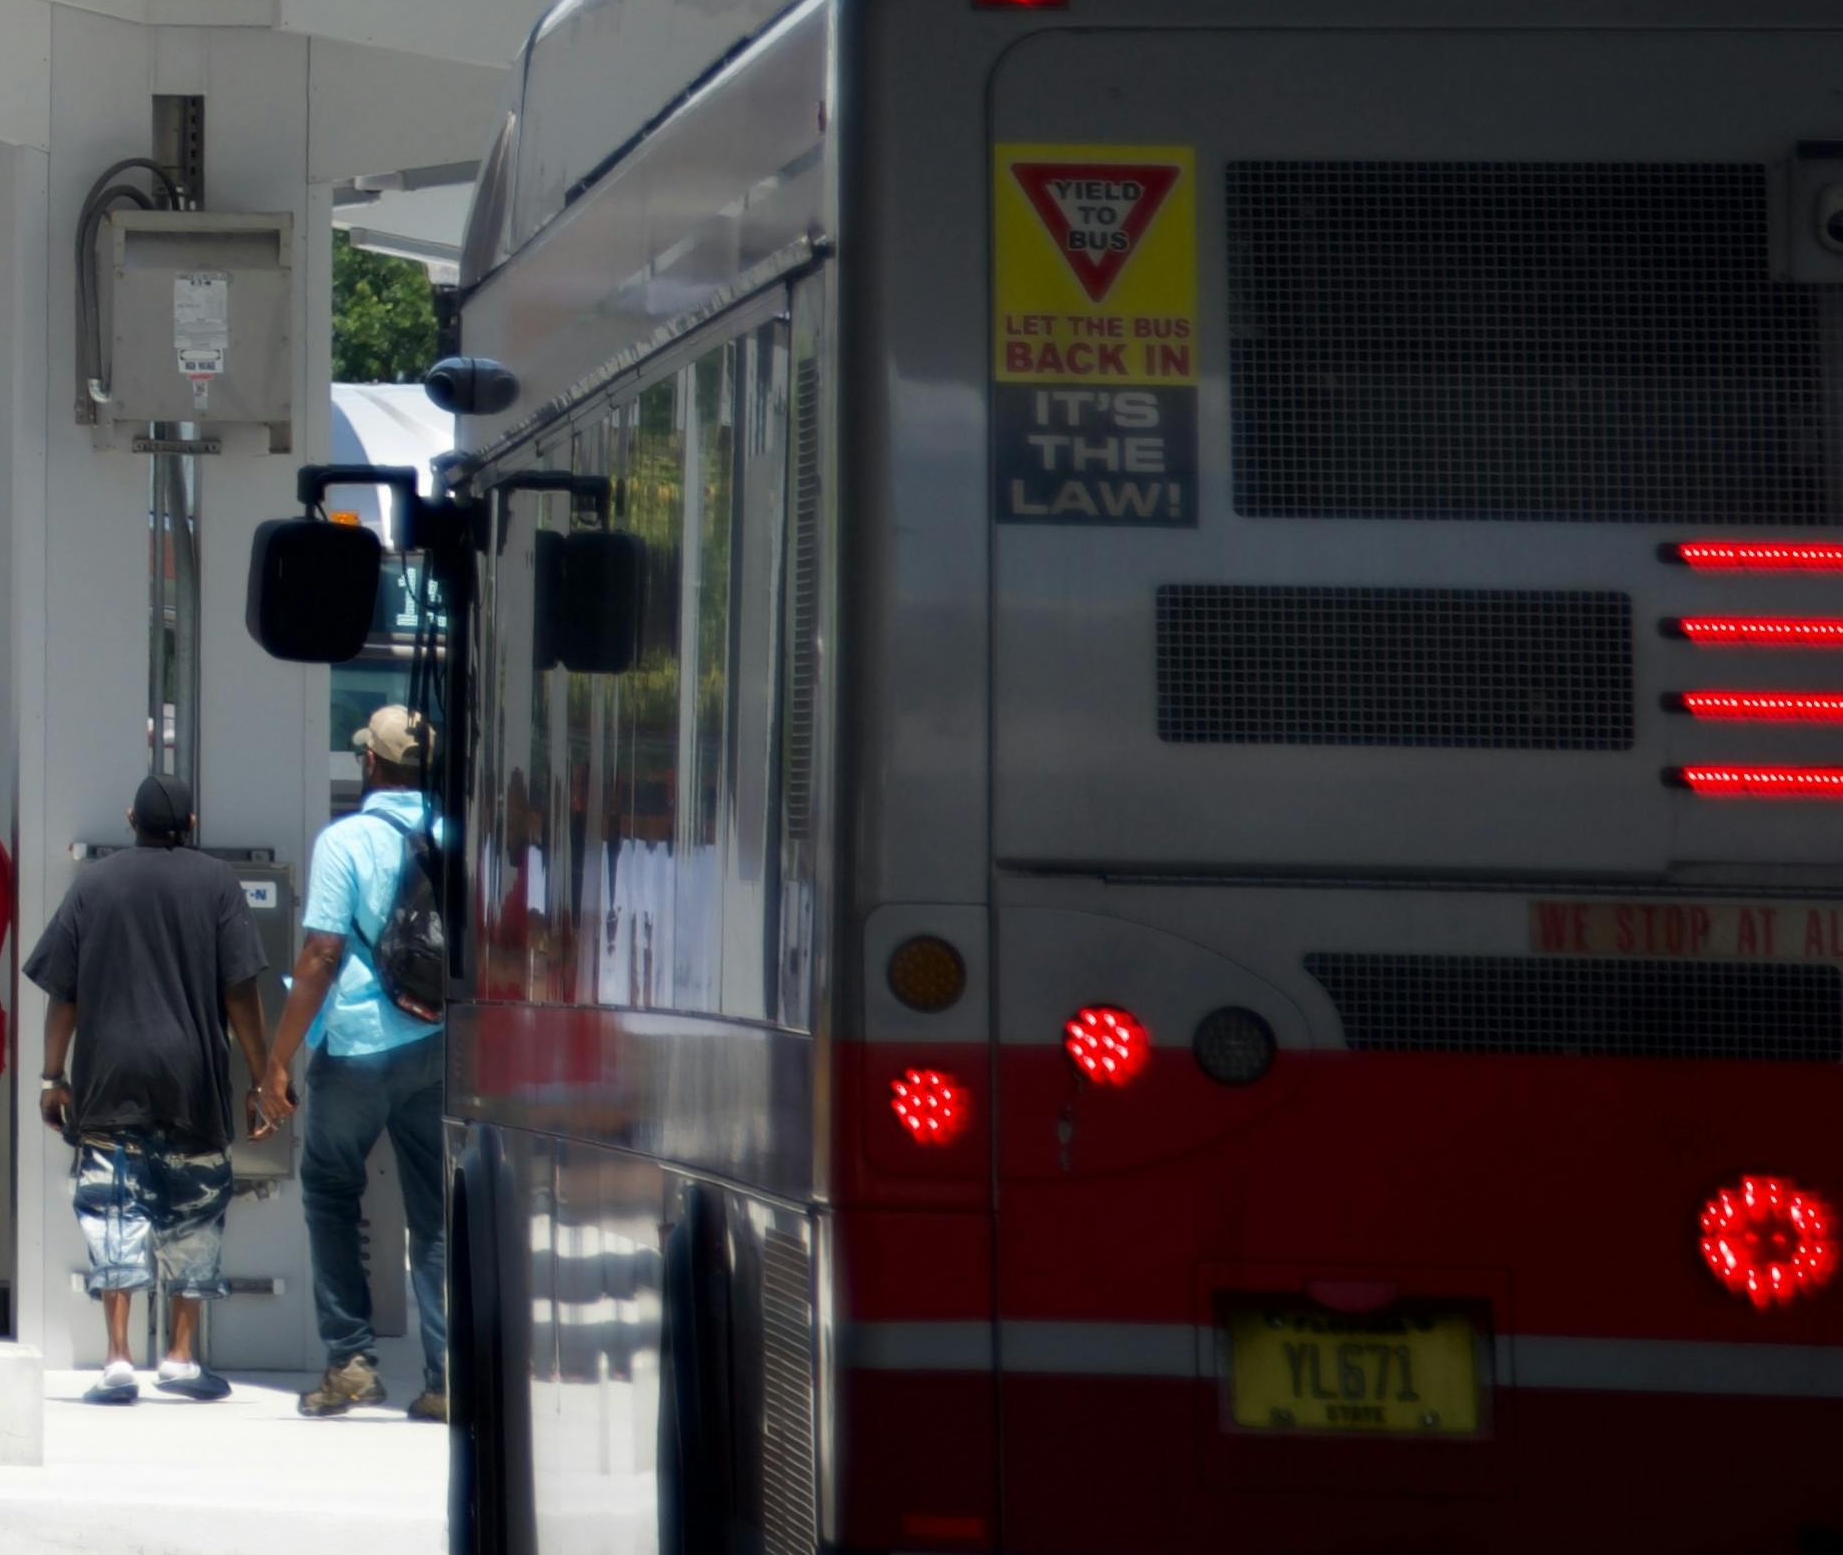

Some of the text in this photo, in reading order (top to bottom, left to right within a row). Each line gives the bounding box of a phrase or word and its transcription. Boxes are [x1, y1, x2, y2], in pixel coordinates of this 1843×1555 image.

[1053, 181, 1142, 202] YIELD
[1078, 206, 1118, 226] TO
[1067, 229, 1129, 251] BUS
[1005, 314, 1191, 338] LET THE BUS
[1005, 340, 1191, 377] BACK IN
[1034, 390, 1161, 429] IT'S
[1027, 434, 1166, 473] THE
[1012, 477, 1182, 520] LAW!
[1537, 900, 1843, 959] WE STOP AT AL
[1283, 1343, 1420, 1402] YL671
